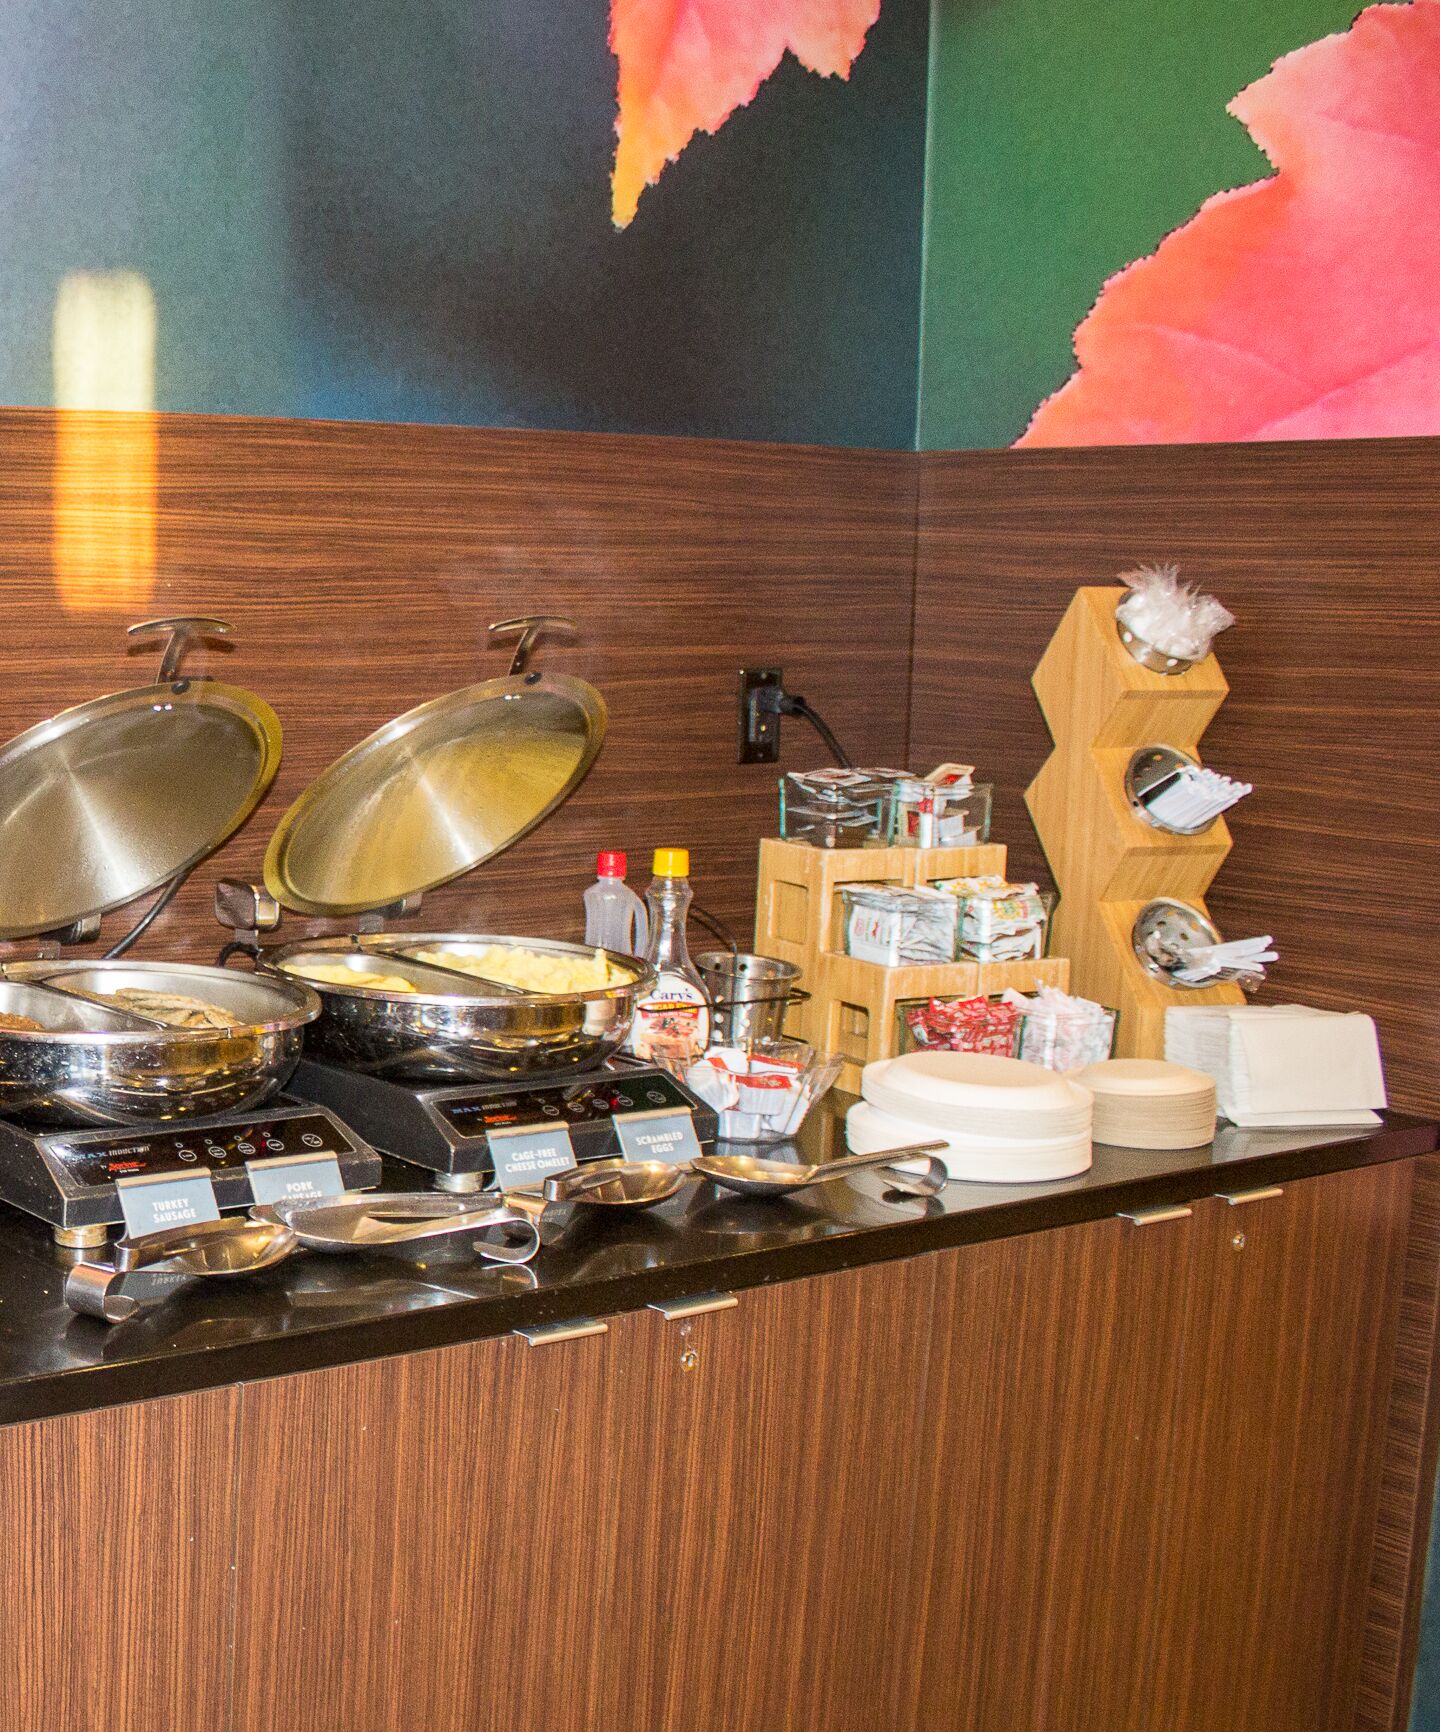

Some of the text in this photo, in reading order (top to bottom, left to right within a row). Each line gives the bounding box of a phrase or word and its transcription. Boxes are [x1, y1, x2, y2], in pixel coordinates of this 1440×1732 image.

[650, 987, 693, 1001] Cary's
[635, 1131, 684, 1146] SCRAMBLED
[511, 1147, 557, 1162] CAGE-FREE
[650, 1142, 675, 1154] EGGS
[505, 1156, 570, 1173] CHEESE OMELET
[285, 1181, 314, 1193] PORK
[151, 1198, 189, 1212] TURKEY
[152, 1208, 197, 1224] SAUSAGE
